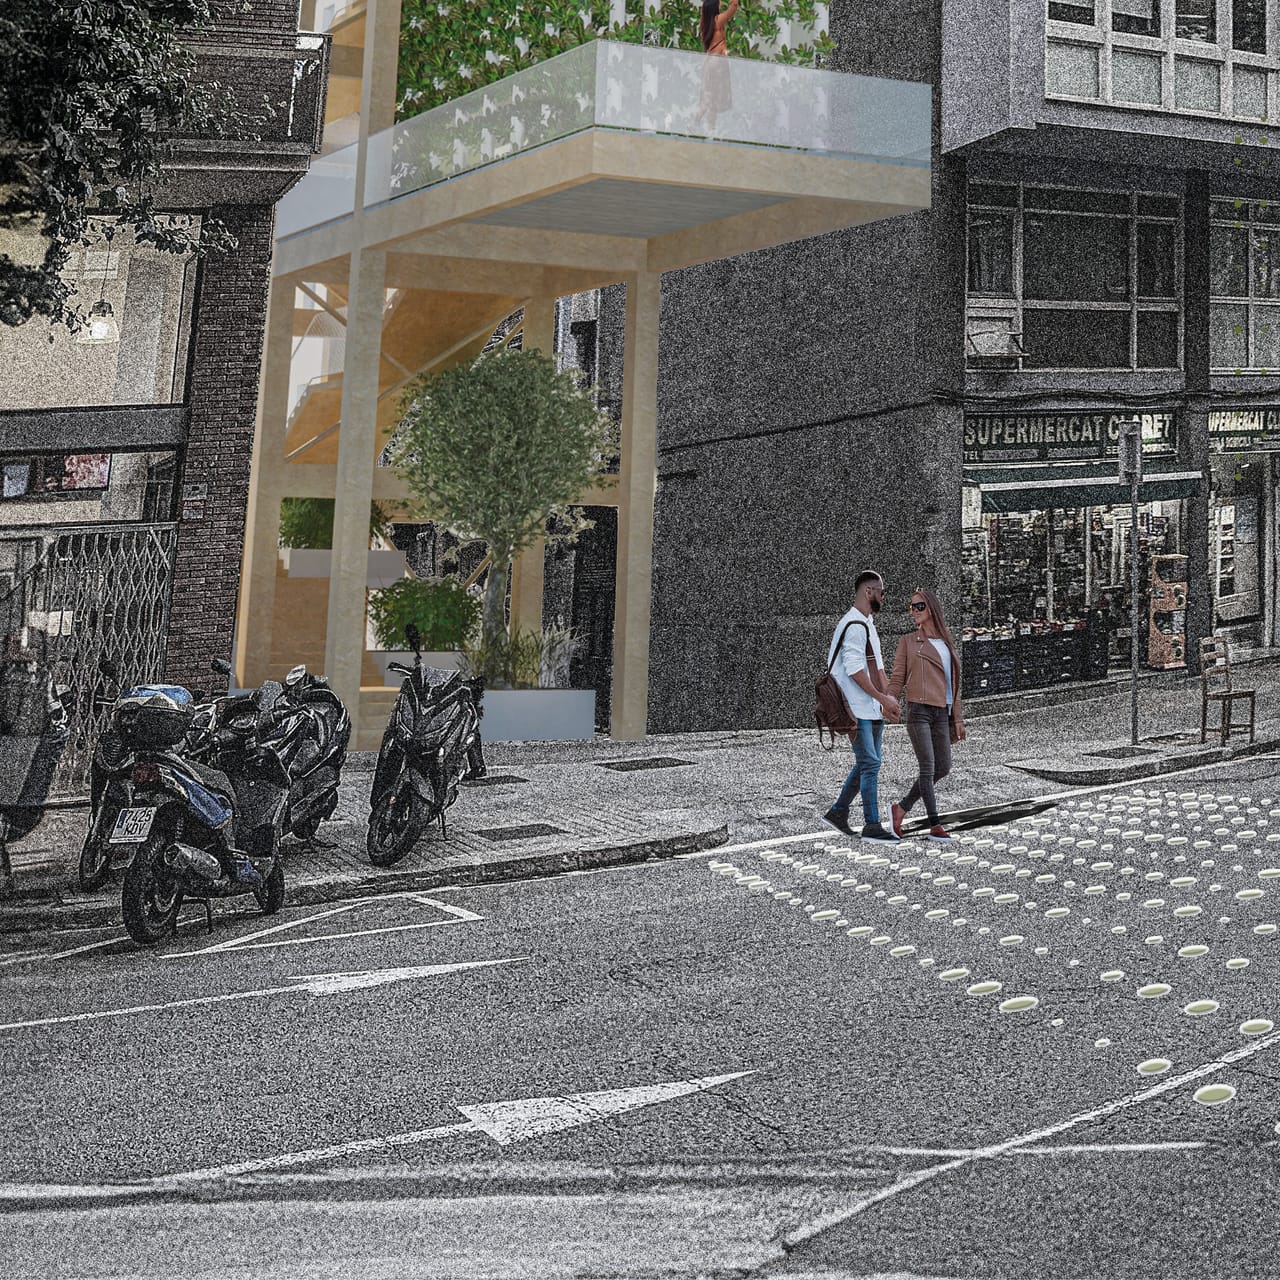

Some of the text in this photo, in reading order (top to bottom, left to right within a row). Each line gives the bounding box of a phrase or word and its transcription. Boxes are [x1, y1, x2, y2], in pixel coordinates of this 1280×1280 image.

[964, 414, 1173, 445] SUPERMERCAT CRET
[1208, 411, 1264, 431] UPERMERCAT
[125, 808, 152, 824] 7425
